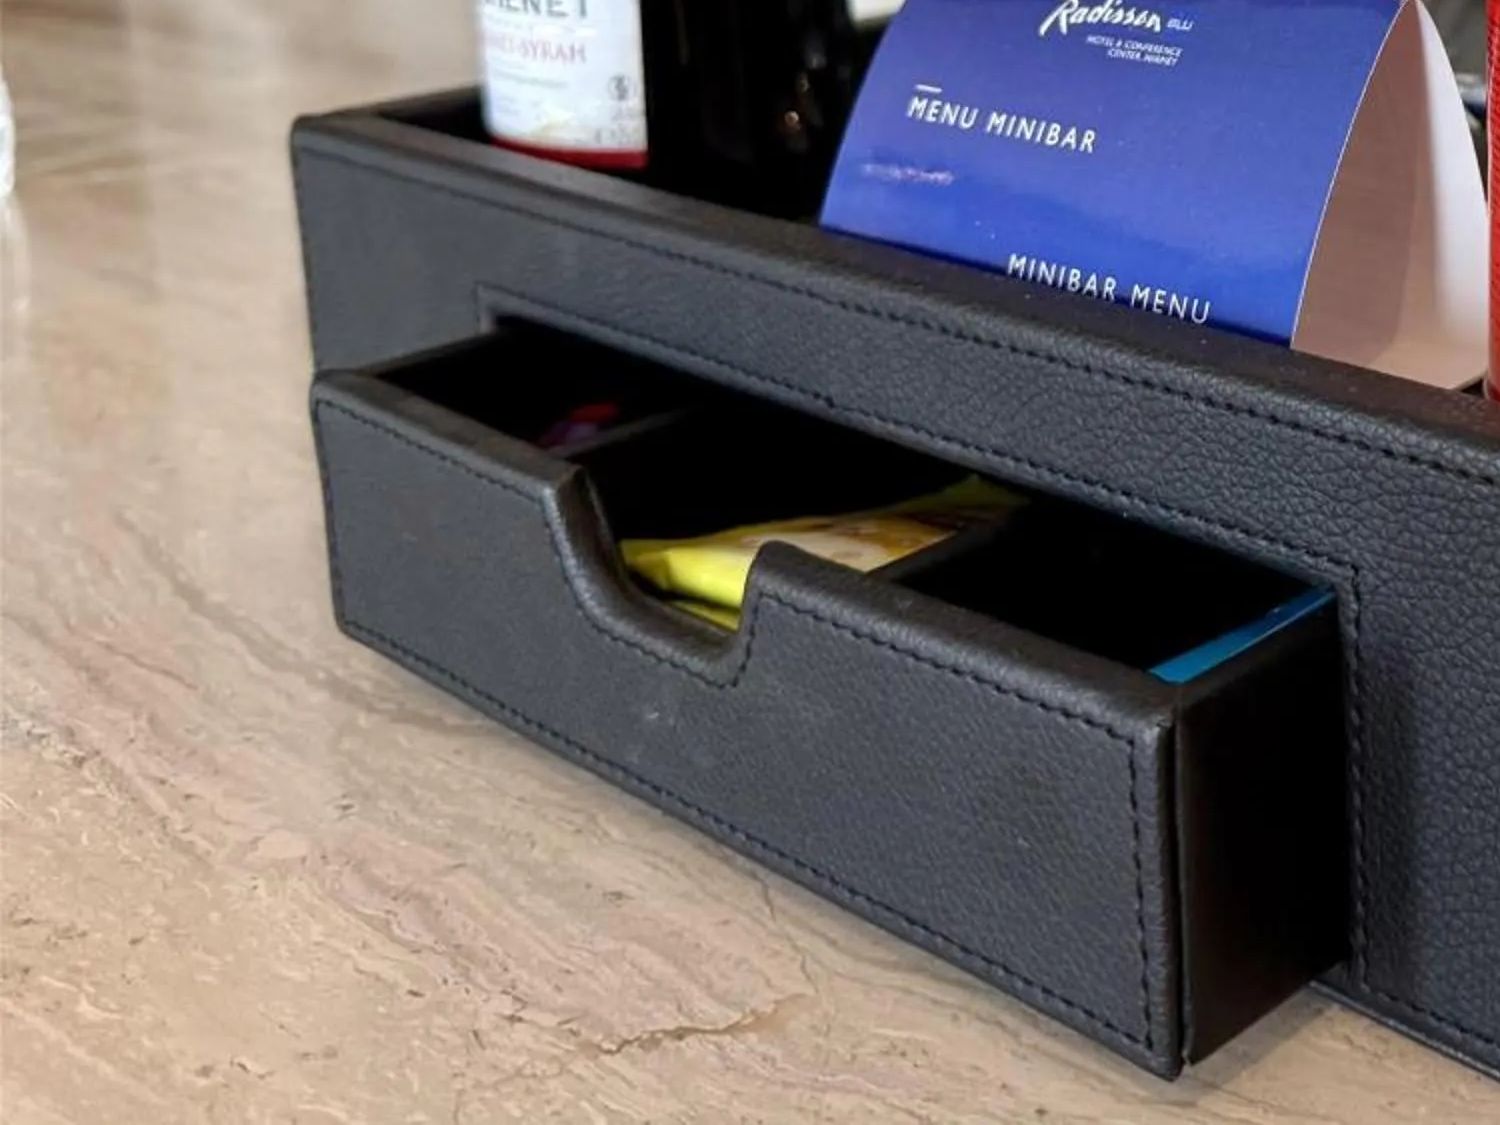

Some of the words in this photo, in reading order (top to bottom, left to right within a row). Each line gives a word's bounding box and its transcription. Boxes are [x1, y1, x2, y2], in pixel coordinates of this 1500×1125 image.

[1123, 39, 1183, 57] CONFERENCE
[905, 95, 980, 130] MENU
[985, 111, 1097, 154] MINIBAR
[1007, 252, 1118, 302] MINIBAR
[1131, 282, 1211, 324] MENU
